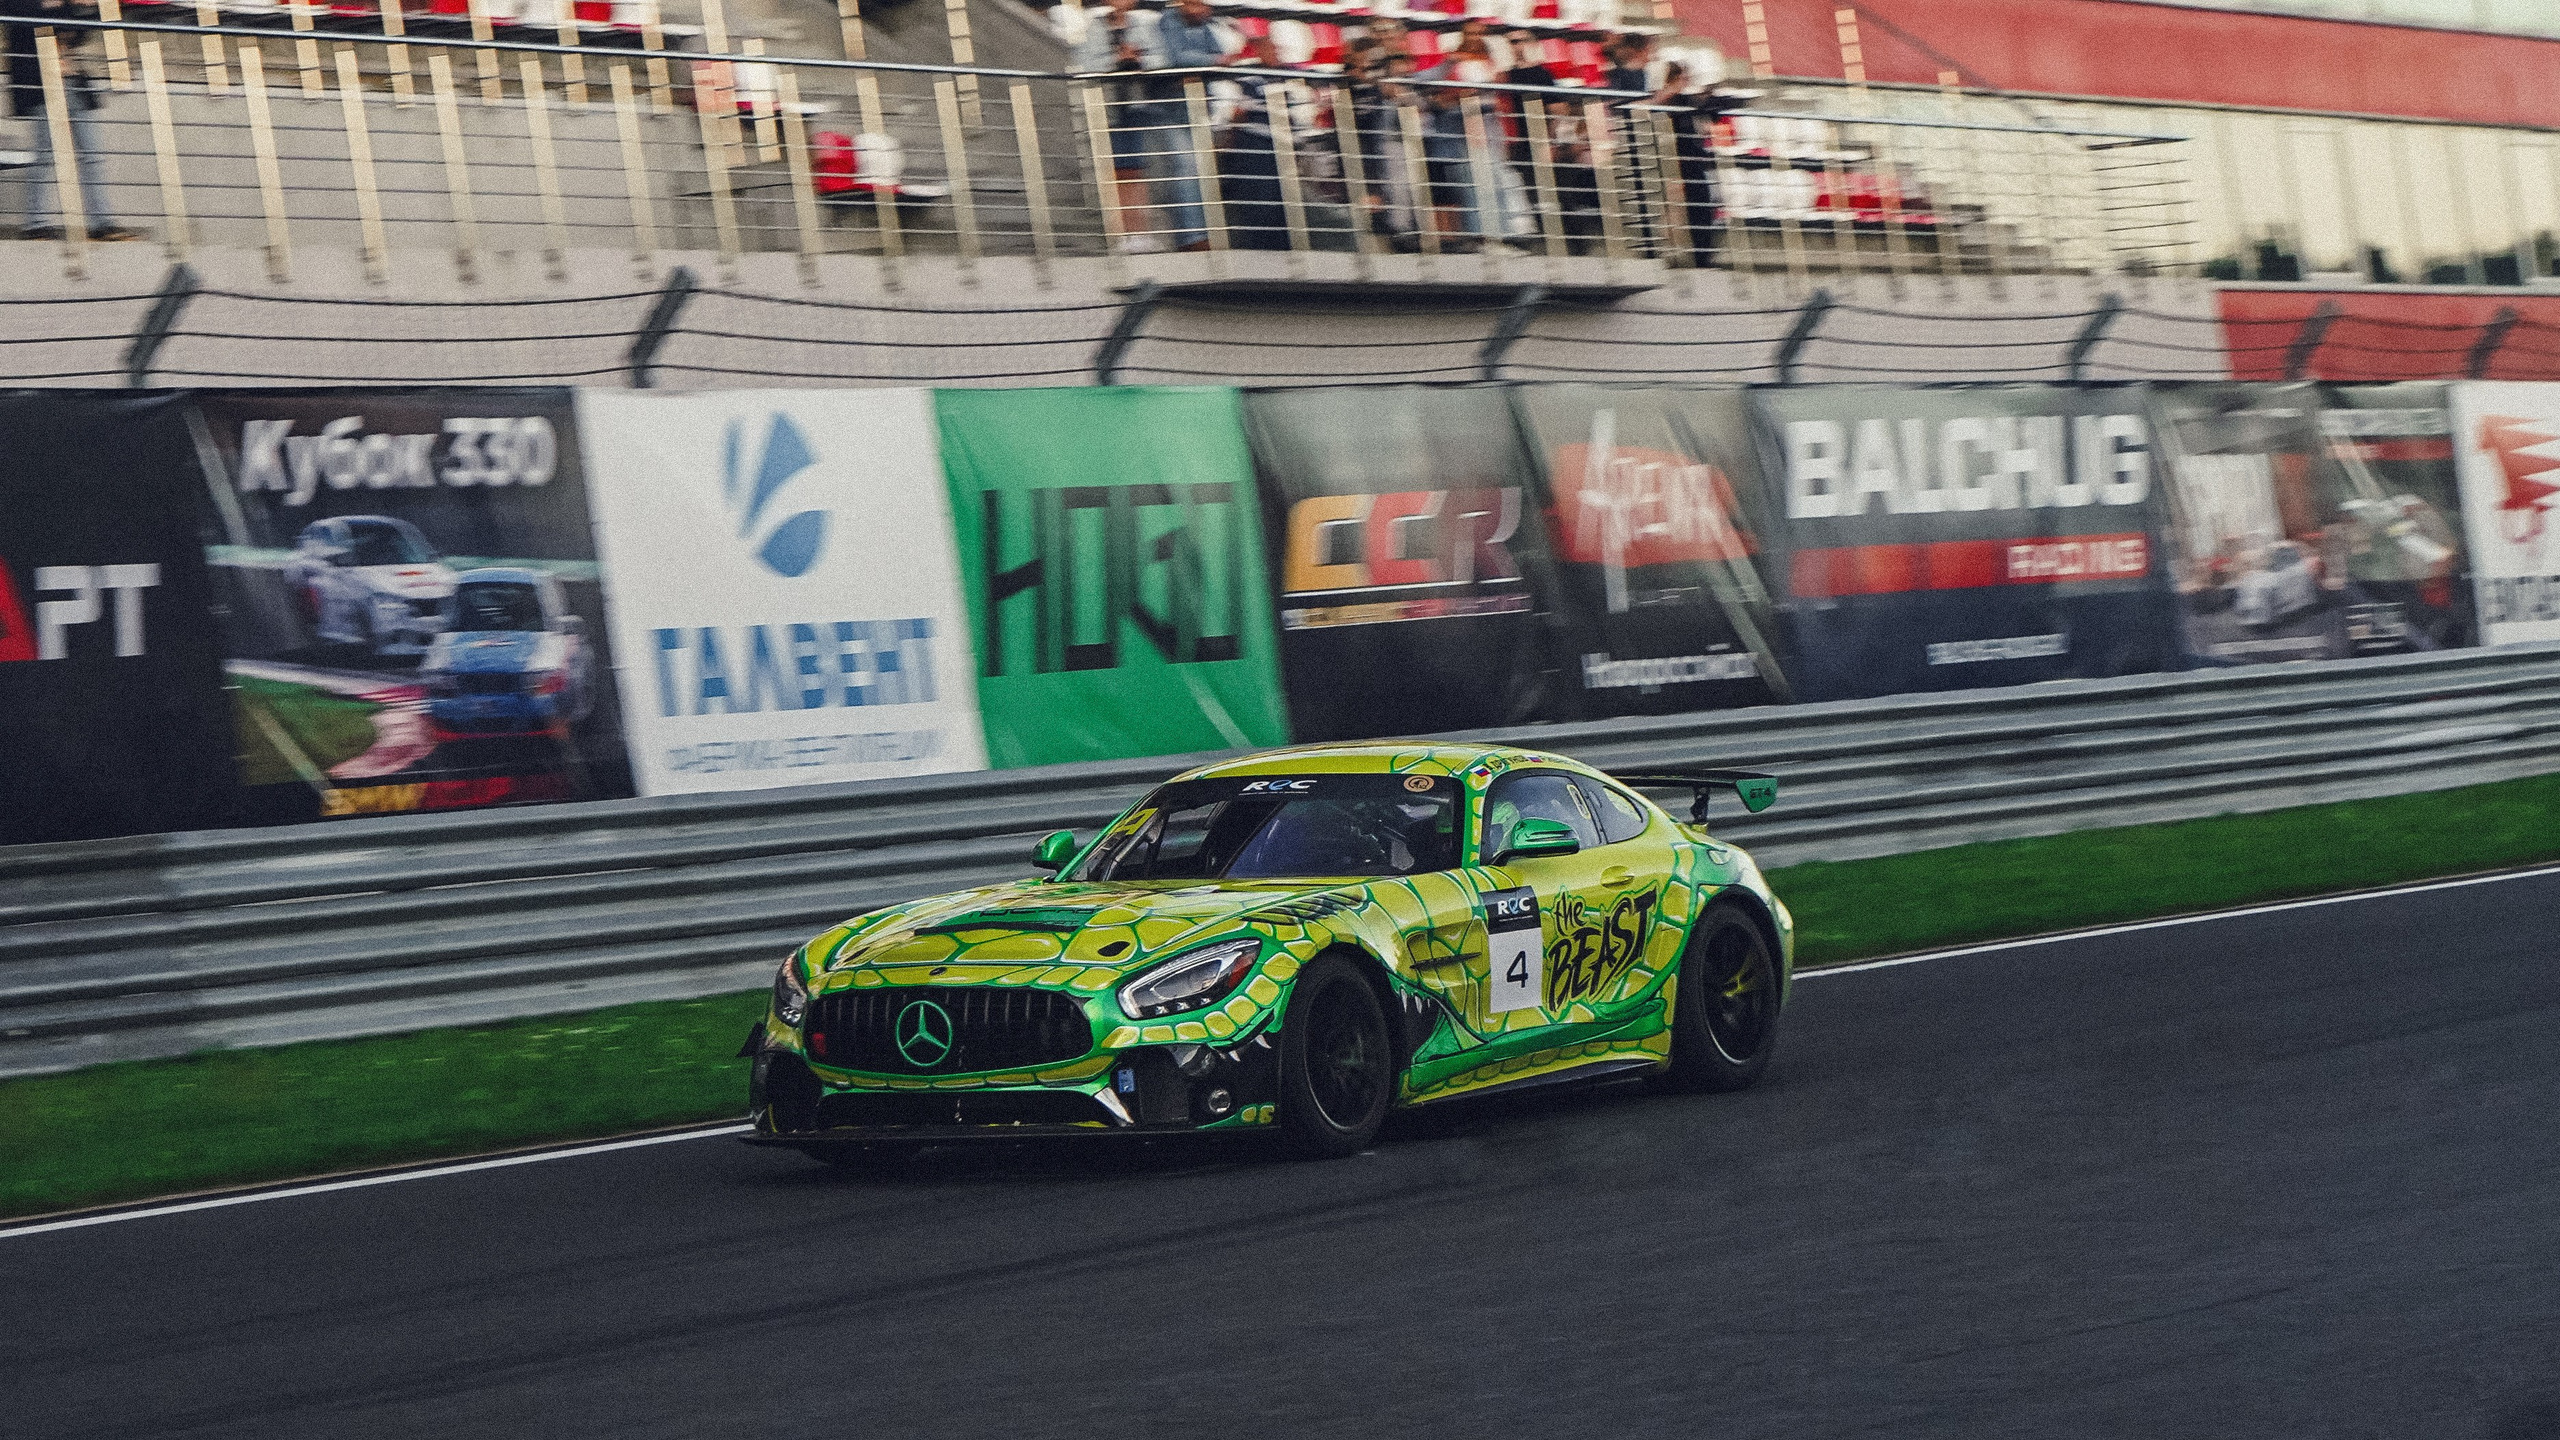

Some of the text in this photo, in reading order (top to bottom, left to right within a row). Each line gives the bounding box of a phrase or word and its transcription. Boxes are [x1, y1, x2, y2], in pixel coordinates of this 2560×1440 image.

[239, 416, 557, 506] Кубок 330
[1785, 415, 2149, 519] BALCHUG
[2006, 539, 2149, 579] RACING
[1554, 893, 1587, 938] the
[1506, 950, 1529, 988] 4
[1547, 890, 1657, 1013] BEAST
